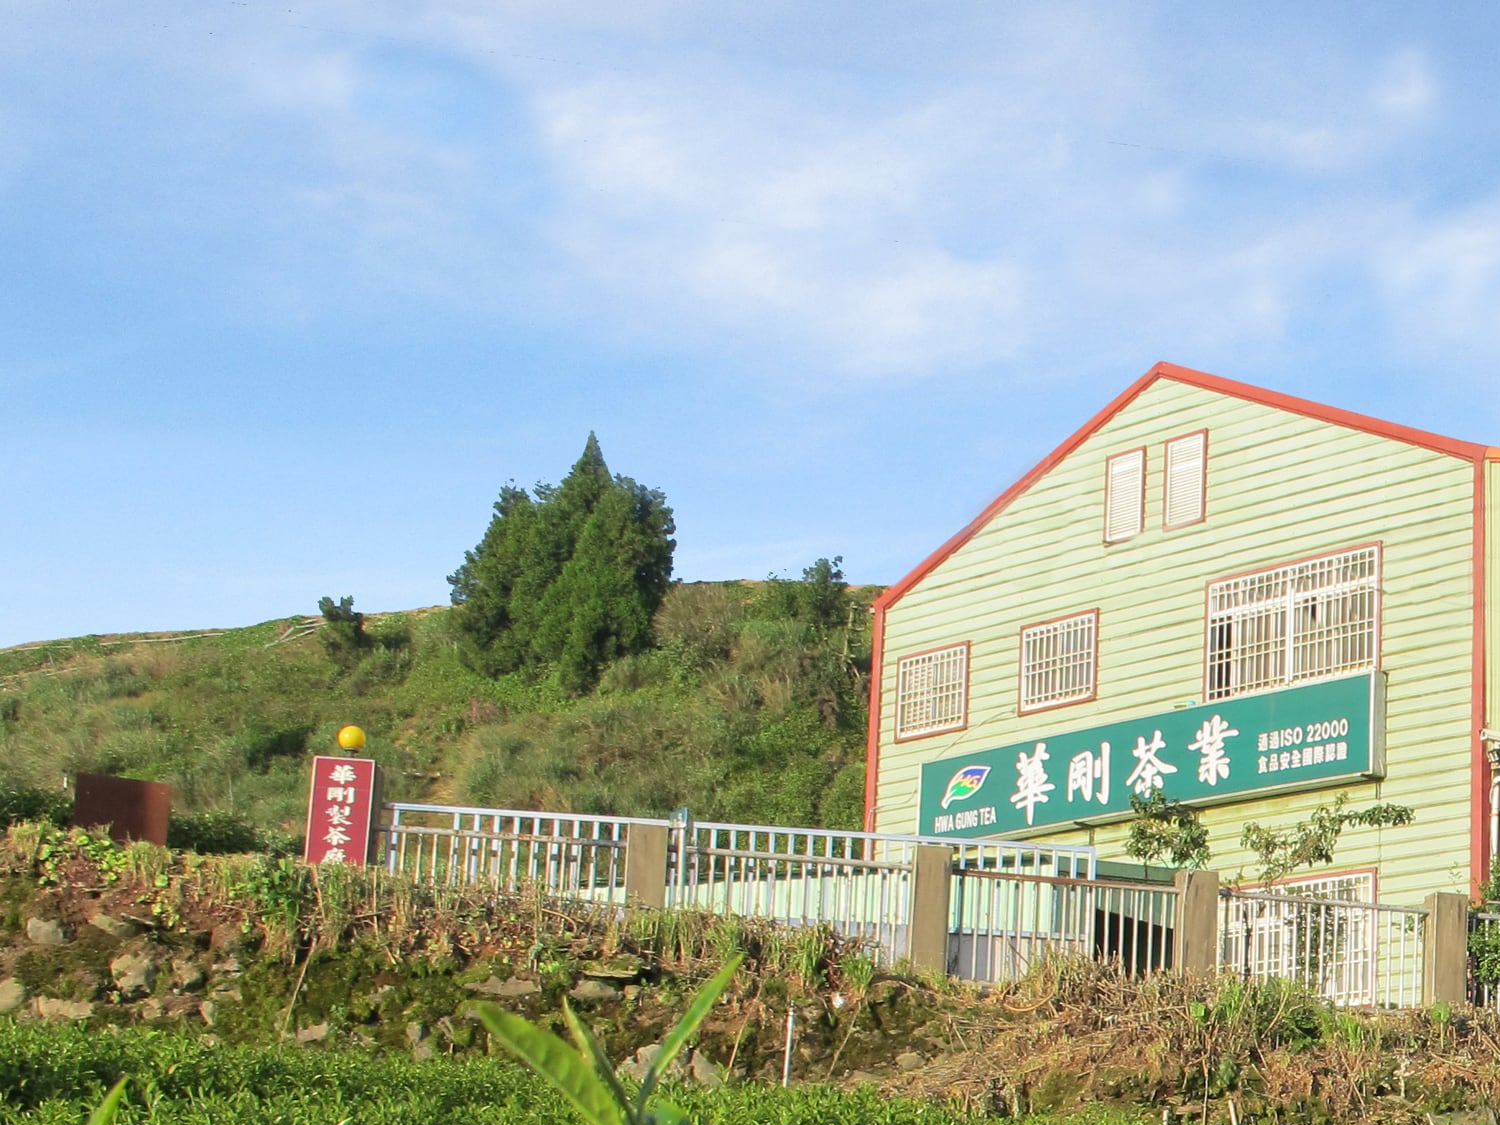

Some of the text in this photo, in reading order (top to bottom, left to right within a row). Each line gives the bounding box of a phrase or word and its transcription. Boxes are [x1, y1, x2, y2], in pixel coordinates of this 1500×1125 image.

[1306, 718, 1348, 743] 22000
[1010, 714, 1239, 825] 華剛茶業
[1258, 741, 1348, 774] 食品安全國際認證
[934, 806, 997, 834] HWA GUNG TEA
